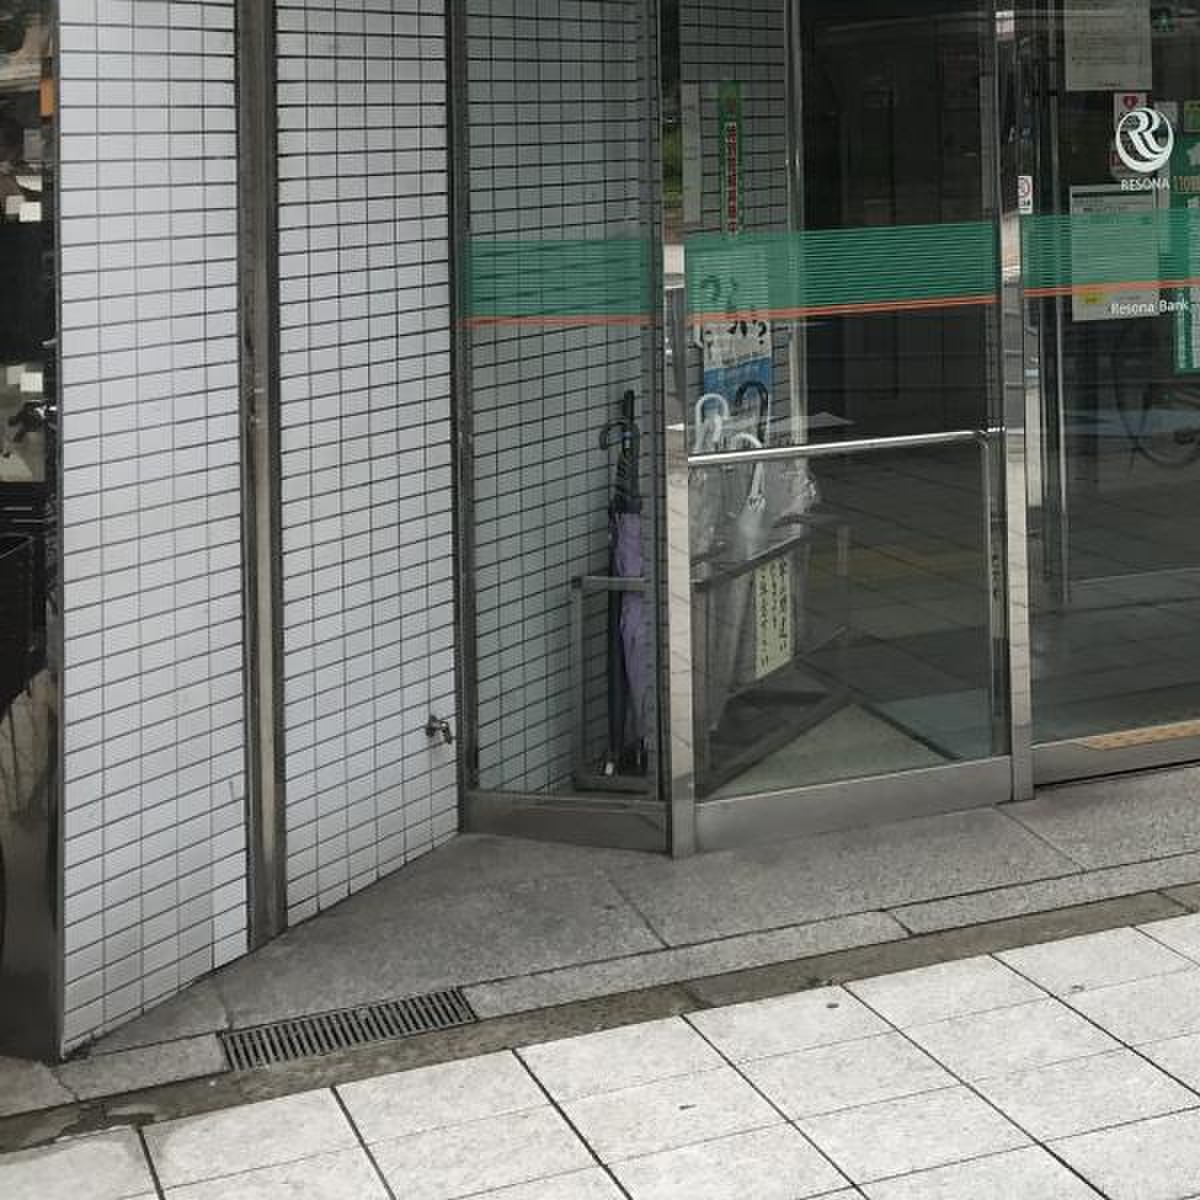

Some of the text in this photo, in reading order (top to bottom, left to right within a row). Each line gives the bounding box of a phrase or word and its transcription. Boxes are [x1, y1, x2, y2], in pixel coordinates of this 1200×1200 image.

[1120, 177, 1170, 191] RESONA
[1111, 299, 1189, 315] Resona Bank
